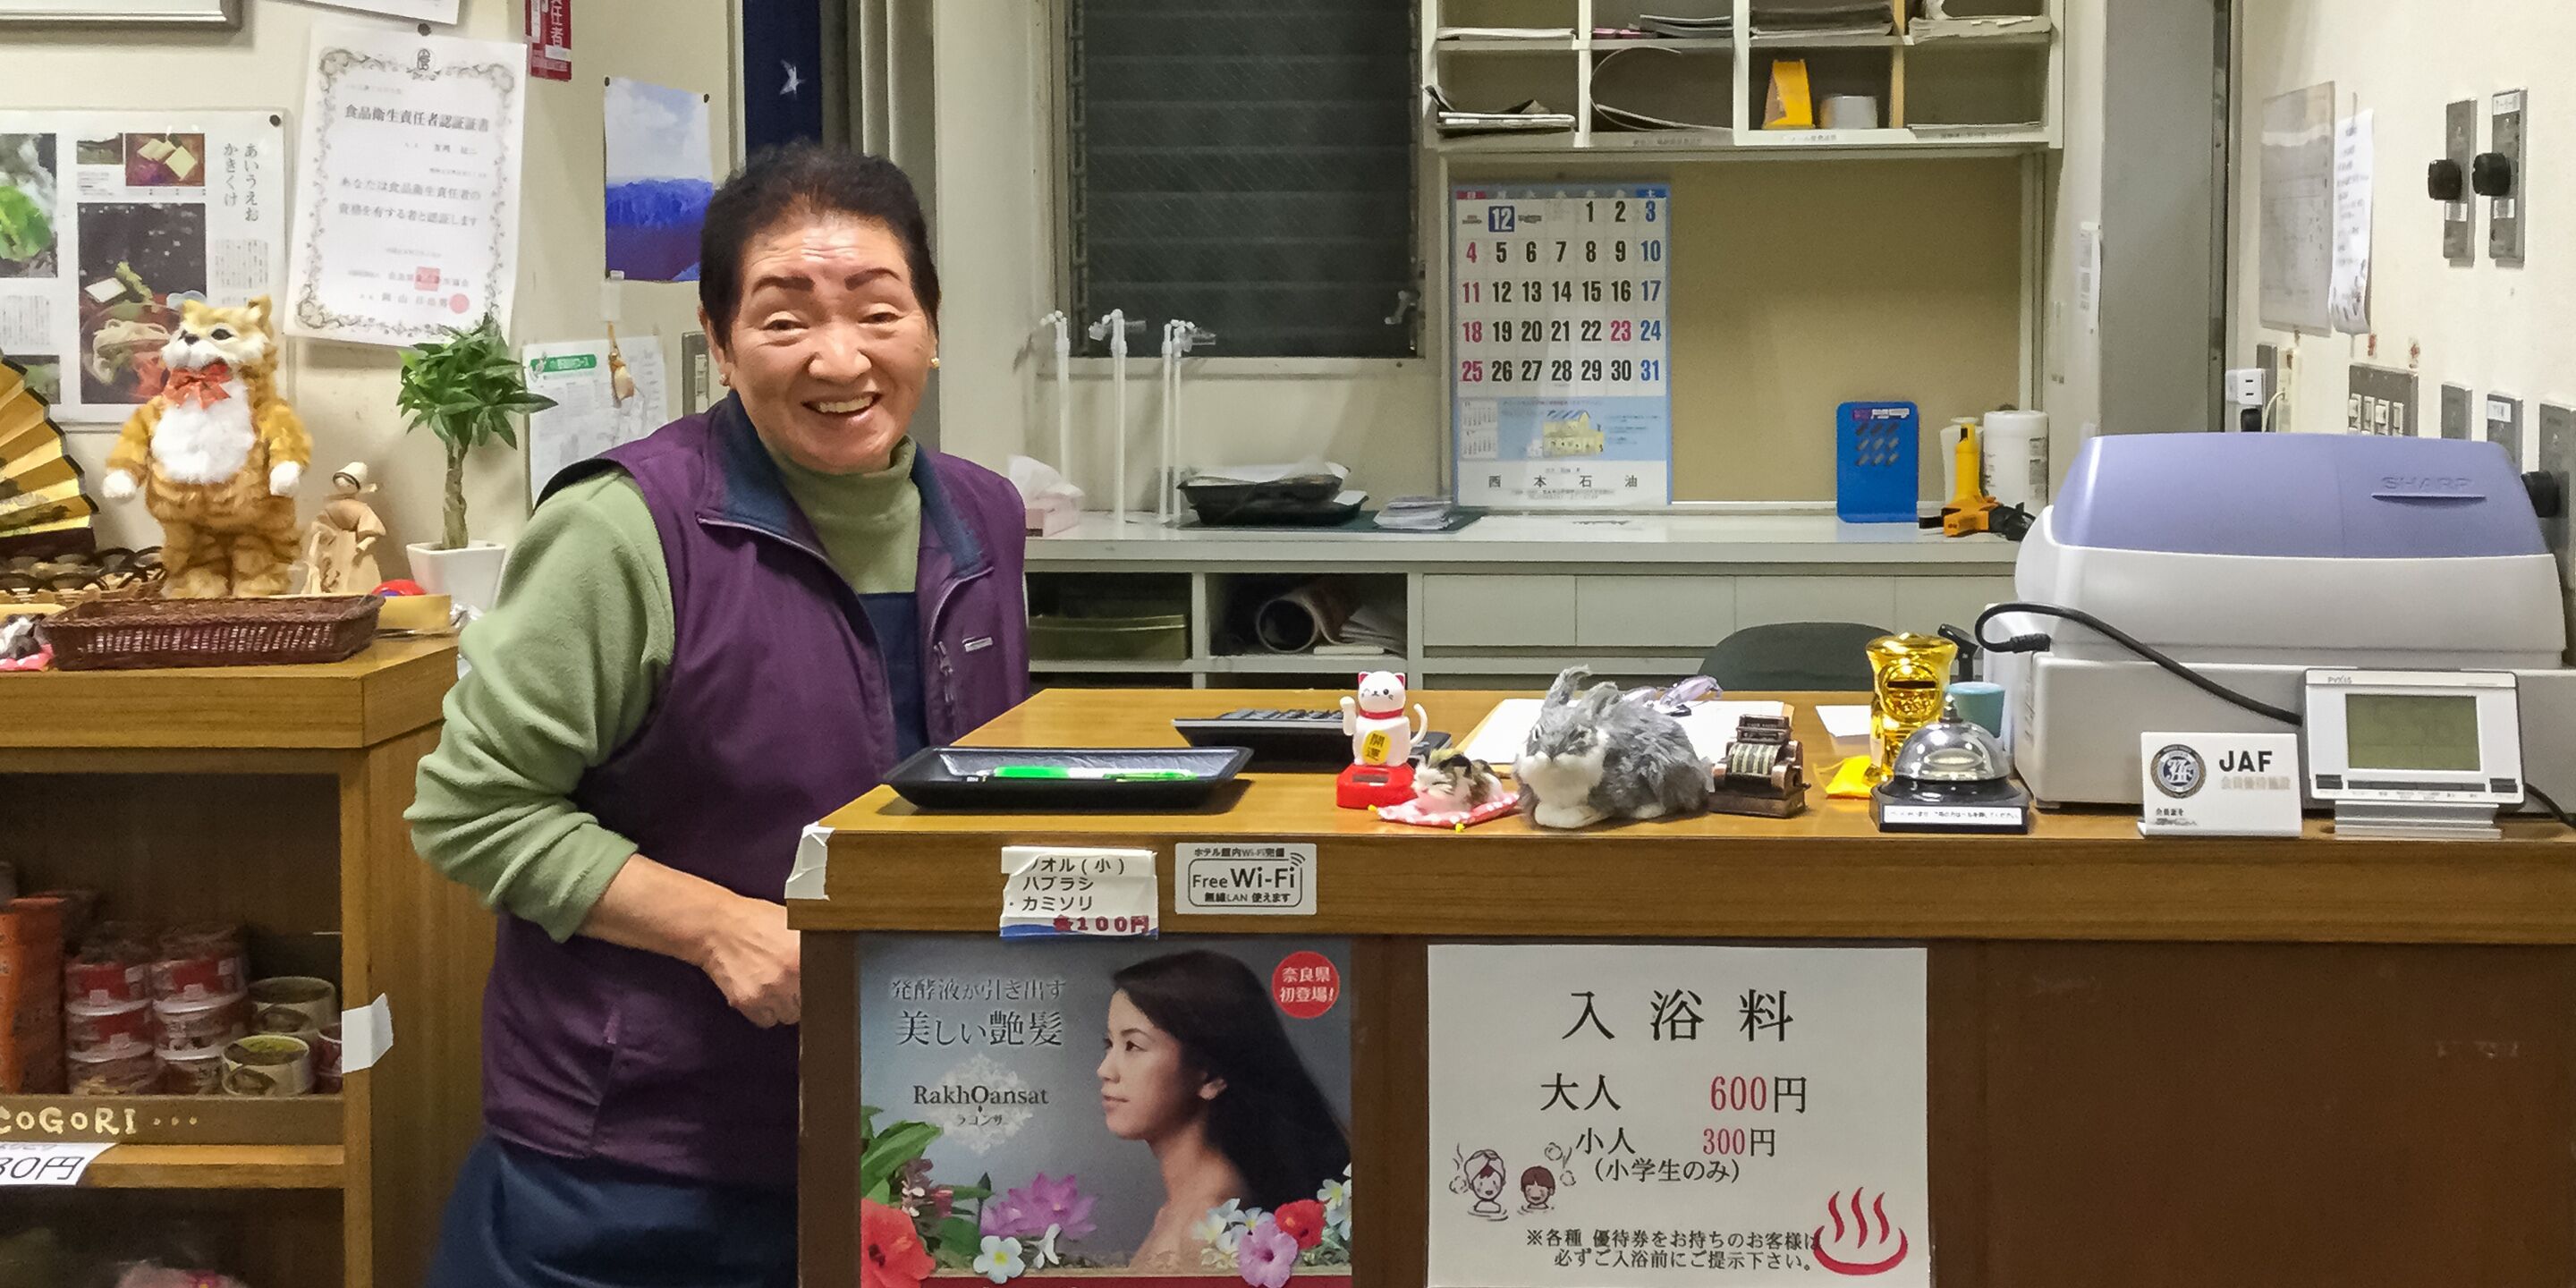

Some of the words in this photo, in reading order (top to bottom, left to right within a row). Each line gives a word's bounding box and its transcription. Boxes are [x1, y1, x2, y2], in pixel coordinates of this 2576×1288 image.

[550, 0, 564, 46] 任者
[224, 142, 239, 207] かきくけ
[244, 142, 259, 222] あいうえお
[1492, 208, 1512, 230] 12
[1586, 200, 1594, 223] 1
[1615, 200, 1626, 223] 2
[1646, 199, 1656, 223] 3
[1466, 242, 1478, 263] 4
[1496, 242, 1507, 263] 5
[1526, 242, 1537, 263] 6
[1555, 242, 1566, 262] 7
[1585, 242, 1597, 262] 8
[1615, 241, 1626, 262] 9
[1641, 240, 1661, 262] 10
[1462, 282, 1480, 303] 11
[1492, 281, 1512, 302] 12
[1521, 281, 1542, 302] 13
[1552, 281, 1572, 302] 14
[1582, 281, 1601, 301] 15
[1611, 280, 1631, 301] 16
[1640, 280, 1661, 301] 17
[1462, 321, 1482, 343] 18
[1492, 321, 1513, 342] 19
[1521, 321, 1542, 342] 20
[1551, 321, 1570, 342] 21
[1580, 320, 1602, 342] 22
[1610, 320, 1631, 342] 23
[1640, 320, 1662, 342] 24
[1462, 361, 1483, 382] 25
[1491, 360, 1513, 382] 26
[1521, 360, 1542, 381] 27
[1551, 360, 1572, 381] 28
[1580, 360, 1602, 381] 29
[1611, 360, 1632, 381] 30
[1640, 360, 1659, 381] 31
[2381, 476, 2473, 489] SHARP
[2219, 750, 2273, 772] JAF
[1022, 877, 1094, 891] ハブラシ
[1192, 874, 1228, 888] Free
[1230, 866, 1295, 888] Wi-Fi
[1252, 892, 1291, 903] 使えます
[1282, 967, 1330, 983] 奈良県
[893, 979, 1067, 1001] 発酵液が引き出す
[895, 1010, 1063, 1046] 美しい艶髪
[913, 1085, 1049, 1105] RakhOansat
[1540, 1072, 1622, 1112] 大人
[1710, 1076, 1807, 1114] 600円
[1575, 1127, 1636, 1156] 小人
[1703, 1128, 1775, 1157] 300円
[1595, 1158, 1740, 1183] (小学生のみ)
[1554, 1249, 1811, 1271] 必ずご入浴前にご提示下さい。
